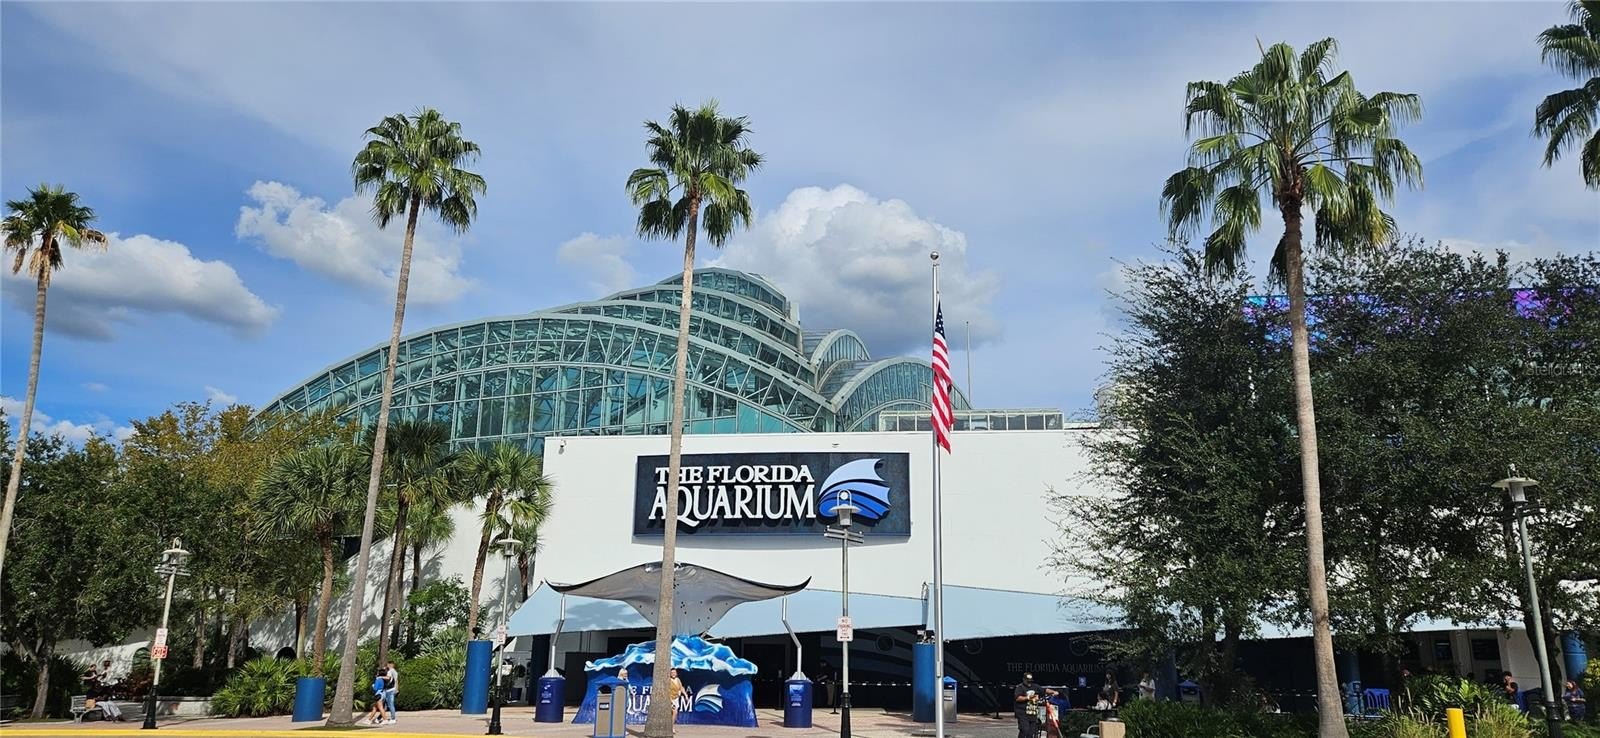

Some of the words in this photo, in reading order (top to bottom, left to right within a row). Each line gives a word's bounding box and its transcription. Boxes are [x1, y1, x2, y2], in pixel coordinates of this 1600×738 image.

[706, 465, 815, 484] FLORIDA
[648, 484, 817, 527] AQUARIUM
[1006, 662, 1023, 672] THE
[1025, 662, 1060, 672] FLORIDA
